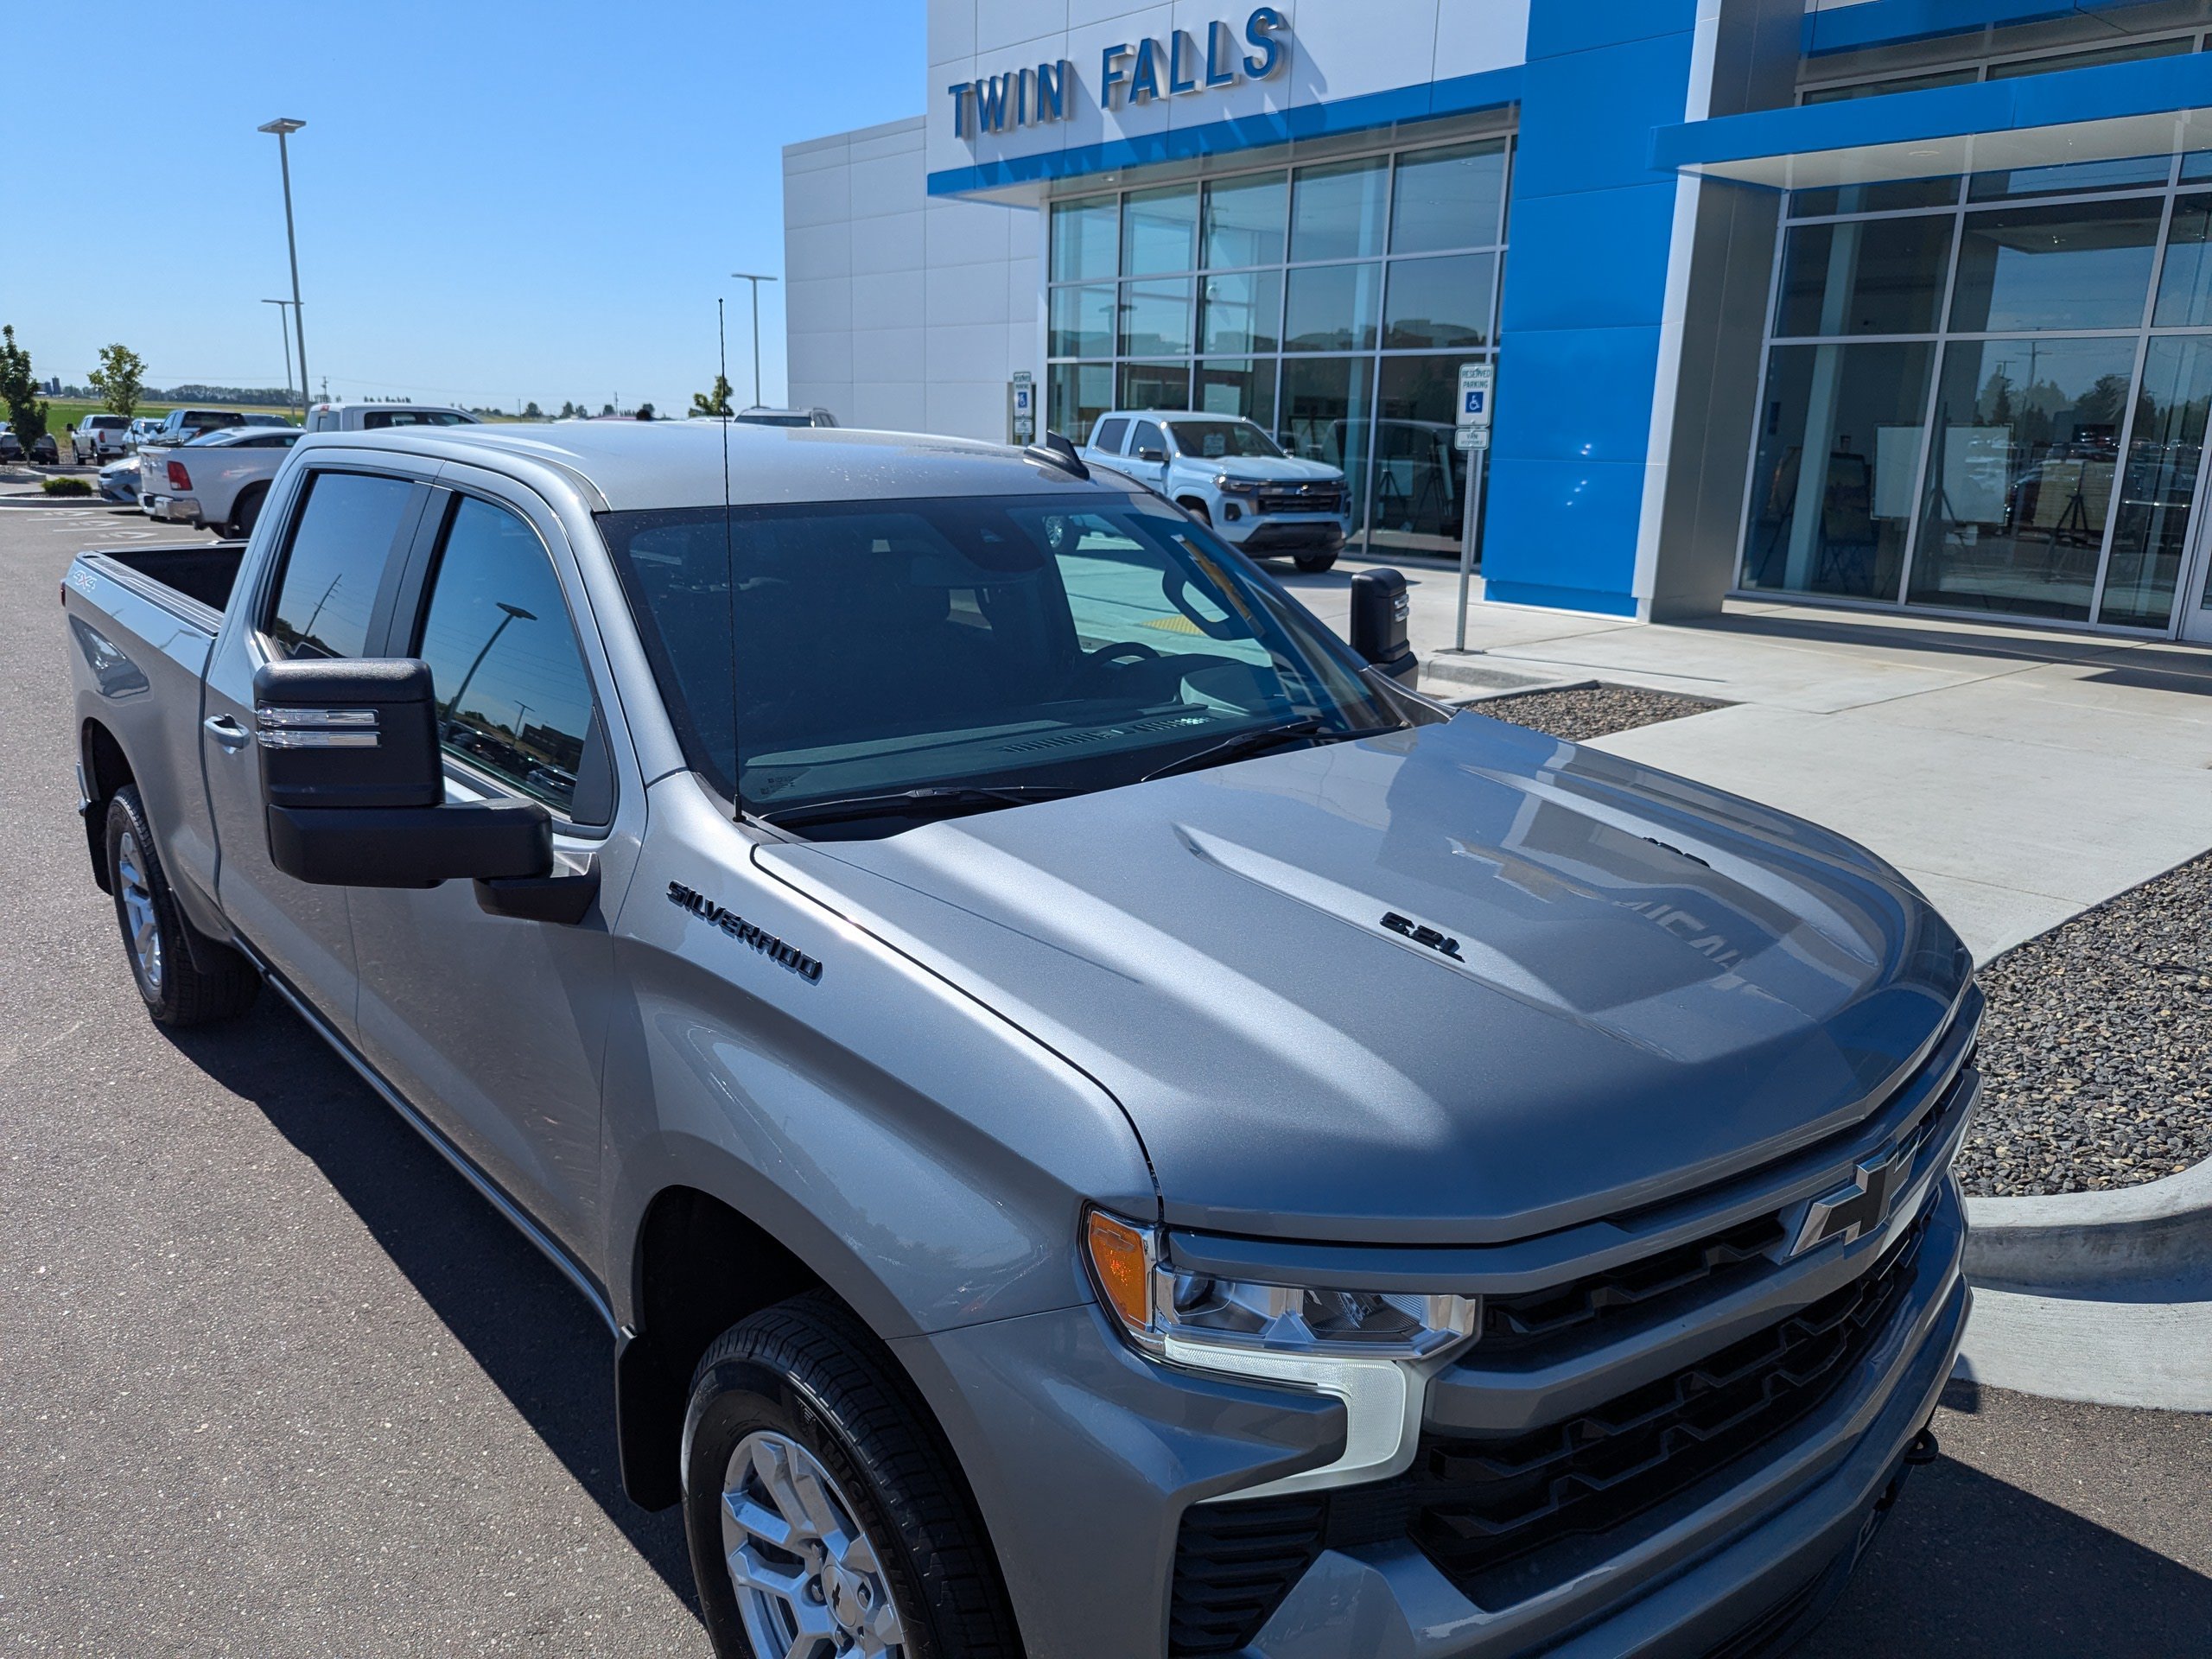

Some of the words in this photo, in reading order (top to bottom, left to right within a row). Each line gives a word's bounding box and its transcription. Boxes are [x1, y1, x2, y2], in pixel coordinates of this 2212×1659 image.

[949, 59, 1071, 138] TWIN
[1101, 7, 1282, 110] FALLS
[1462, 370, 1491, 378] RESERVED
[1463, 380, 1488, 389] PARKING
[666, 880, 823, 983] SILVERADO
[1380, 911, 1465, 963] 6.2L
